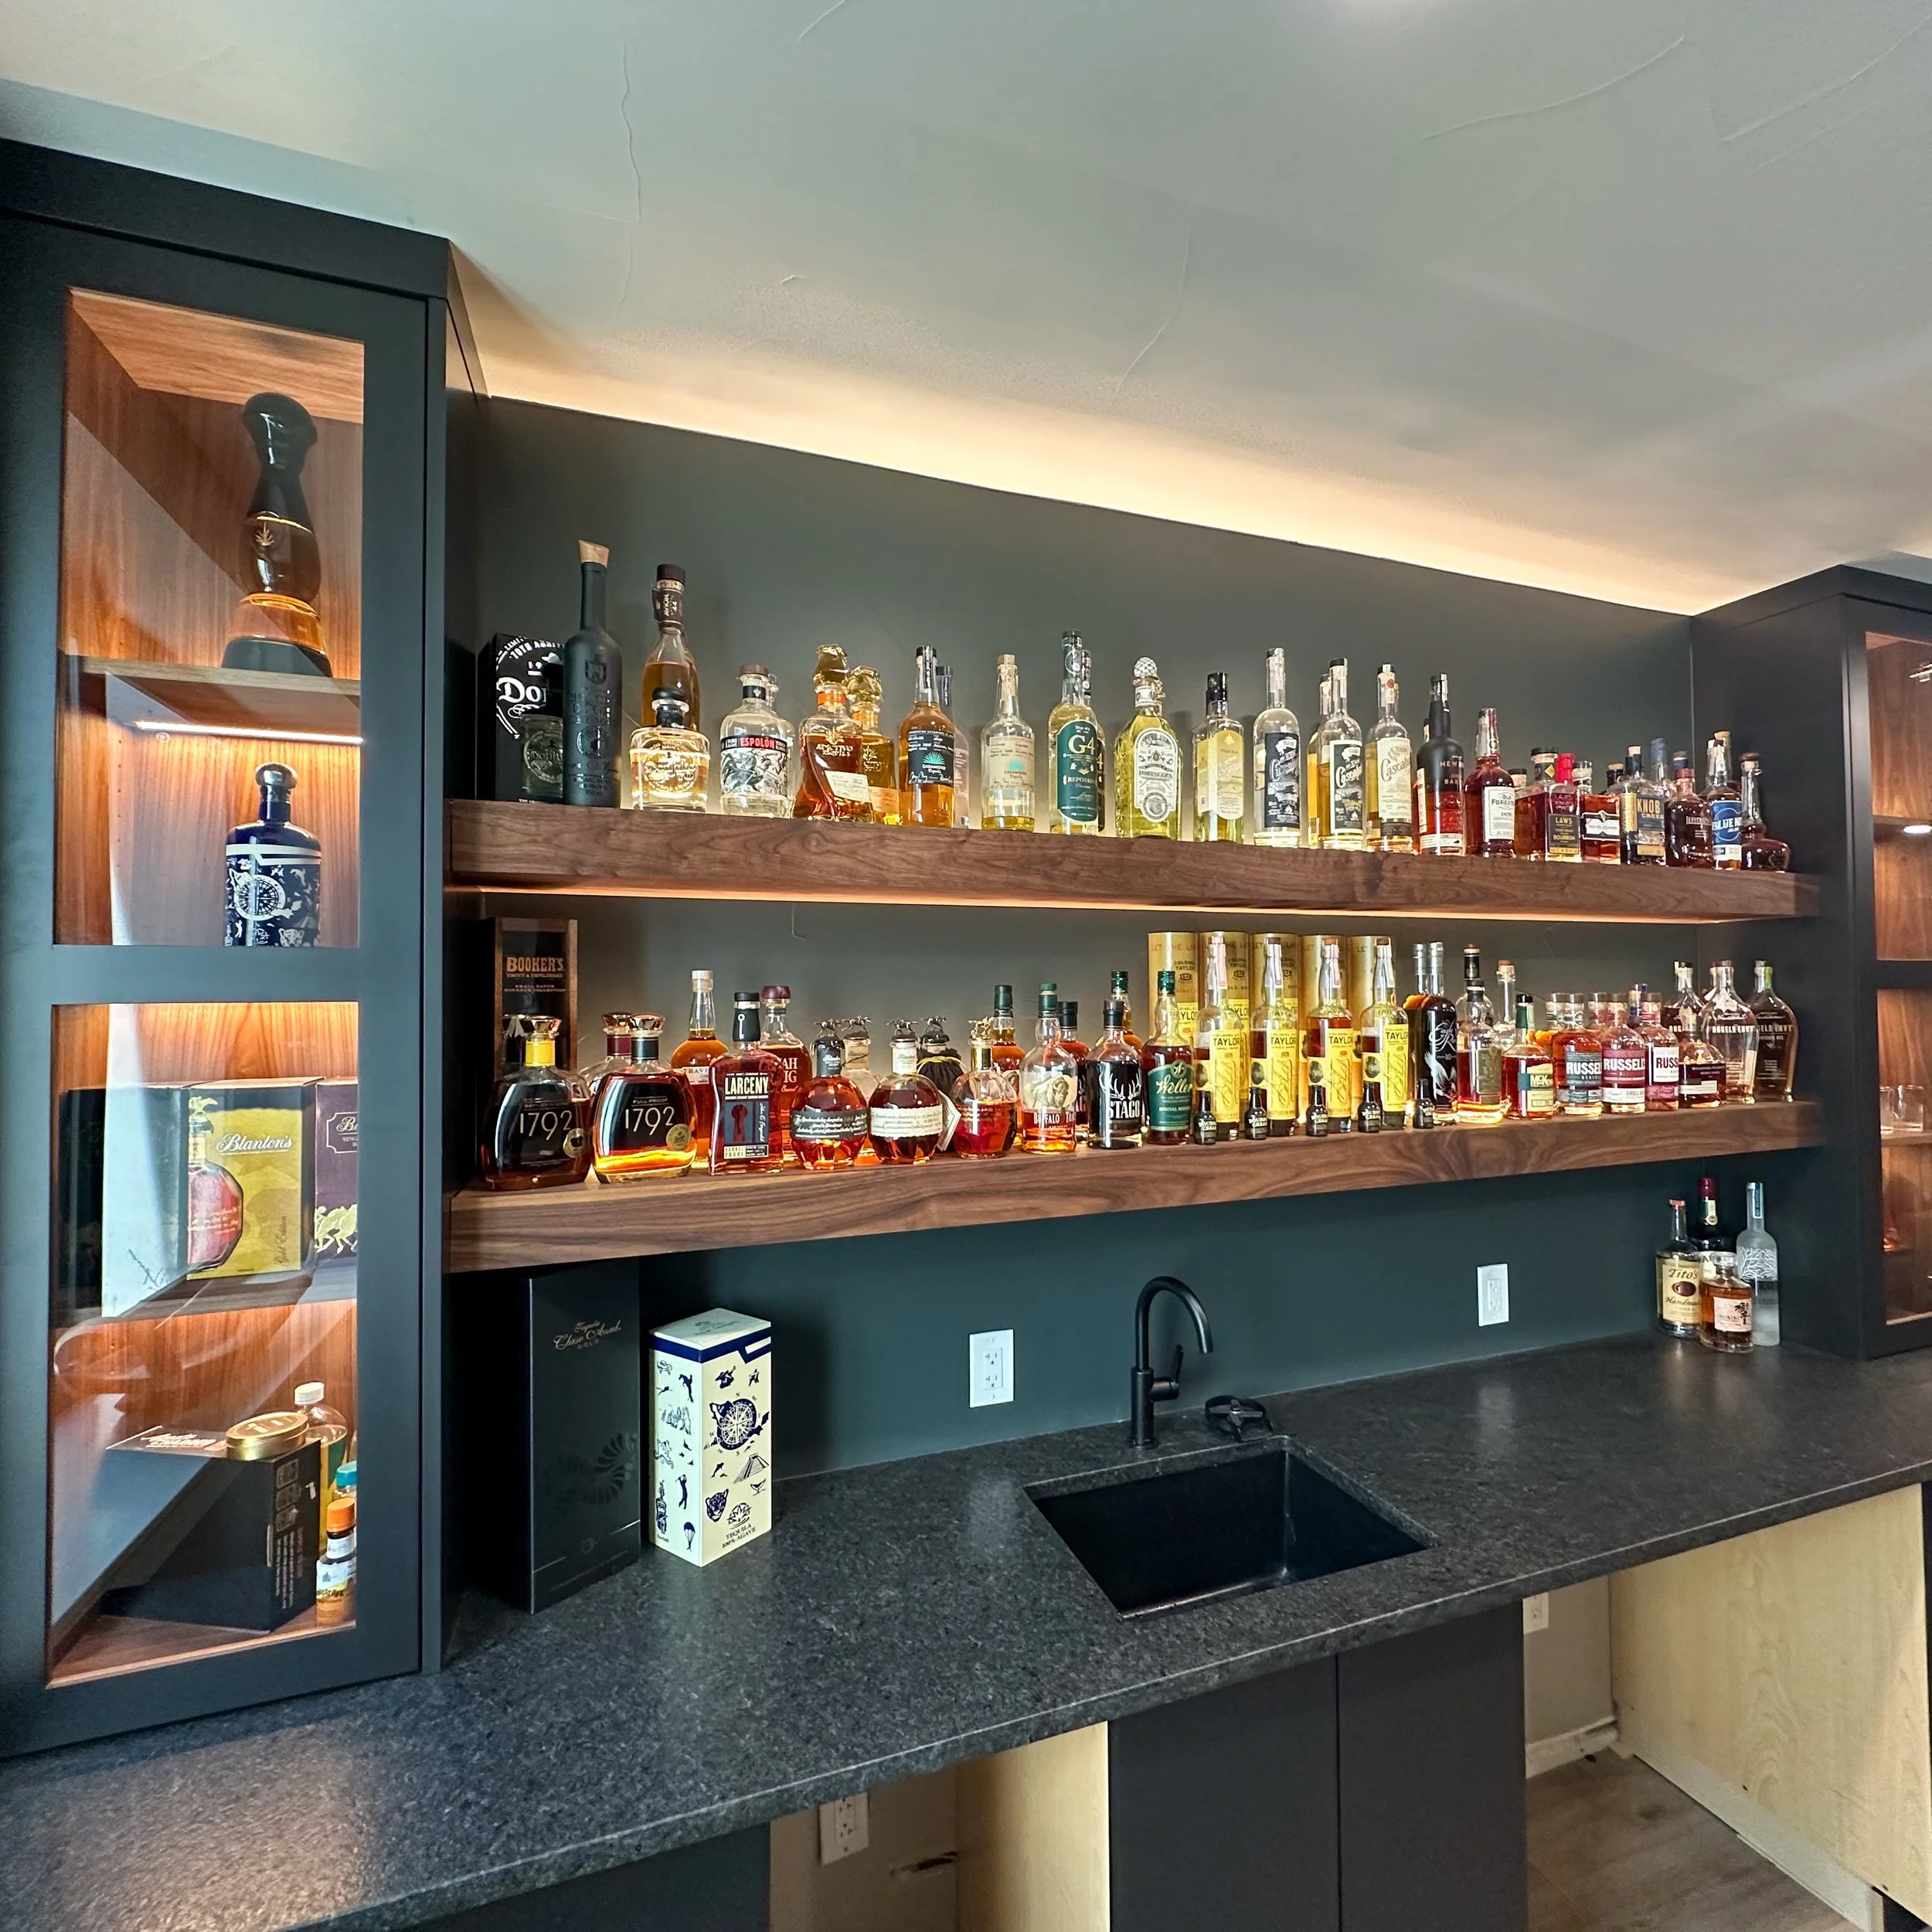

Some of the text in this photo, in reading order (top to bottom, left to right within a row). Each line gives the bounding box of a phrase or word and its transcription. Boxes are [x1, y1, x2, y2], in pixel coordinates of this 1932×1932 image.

[1068, 734, 1096, 756] G4
[1637, 798, 1661, 814] KNOB
[1713, 819, 1733, 831] BLUE
[506, 956, 564, 972] BOOKER'S
[724, 1076, 769, 1095] LARCENY
[1155, 1074, 1195, 1094] Weller
[519, 1110, 573, 1141] 1792
[624, 1106, 675, 1136] 1792
[1033, 1112, 1060, 1124] BUFALO
[216, 1133, 292, 1152] Blanton's
[1668, 1268, 1698, 1279] Tito's
[553, 1334, 584, 1351] Clase
[726, 1523, 752, 1540] TEQUILA
[737, 1526, 756, 1539] AGAVE
